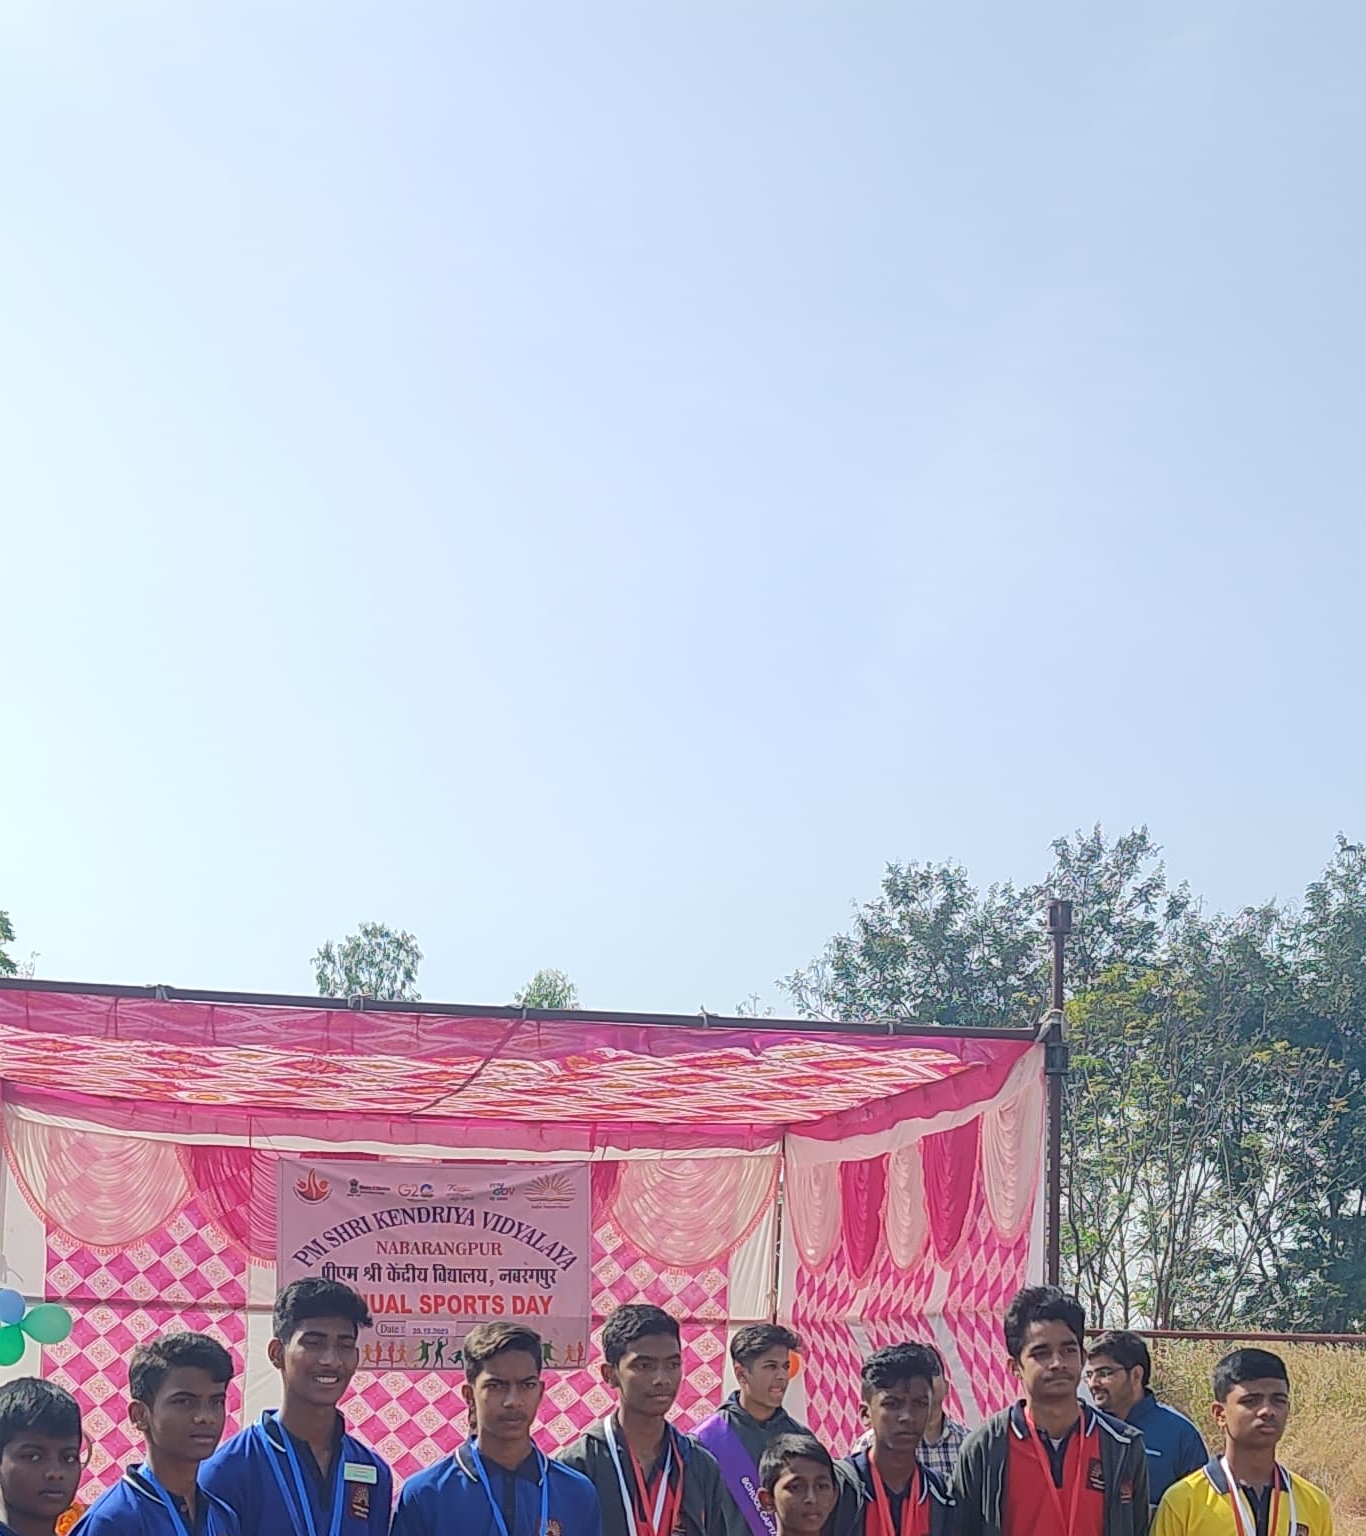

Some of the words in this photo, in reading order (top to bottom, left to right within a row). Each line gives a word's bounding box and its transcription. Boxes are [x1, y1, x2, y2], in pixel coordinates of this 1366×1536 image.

[291, 1238, 332, 1268] PM
[322, 1216, 373, 1248] SHRI
[372, 1206, 475, 1230] KENDRIYA
[482, 1211, 578, 1272] VIDYALAYA
[376, 1241, 504, 1256] NABARANGPUR
[363, 1262, 383, 1283] श्री
[419, 1294, 505, 1315] SPORTS
[512, 1295, 553, 1315] DAY
